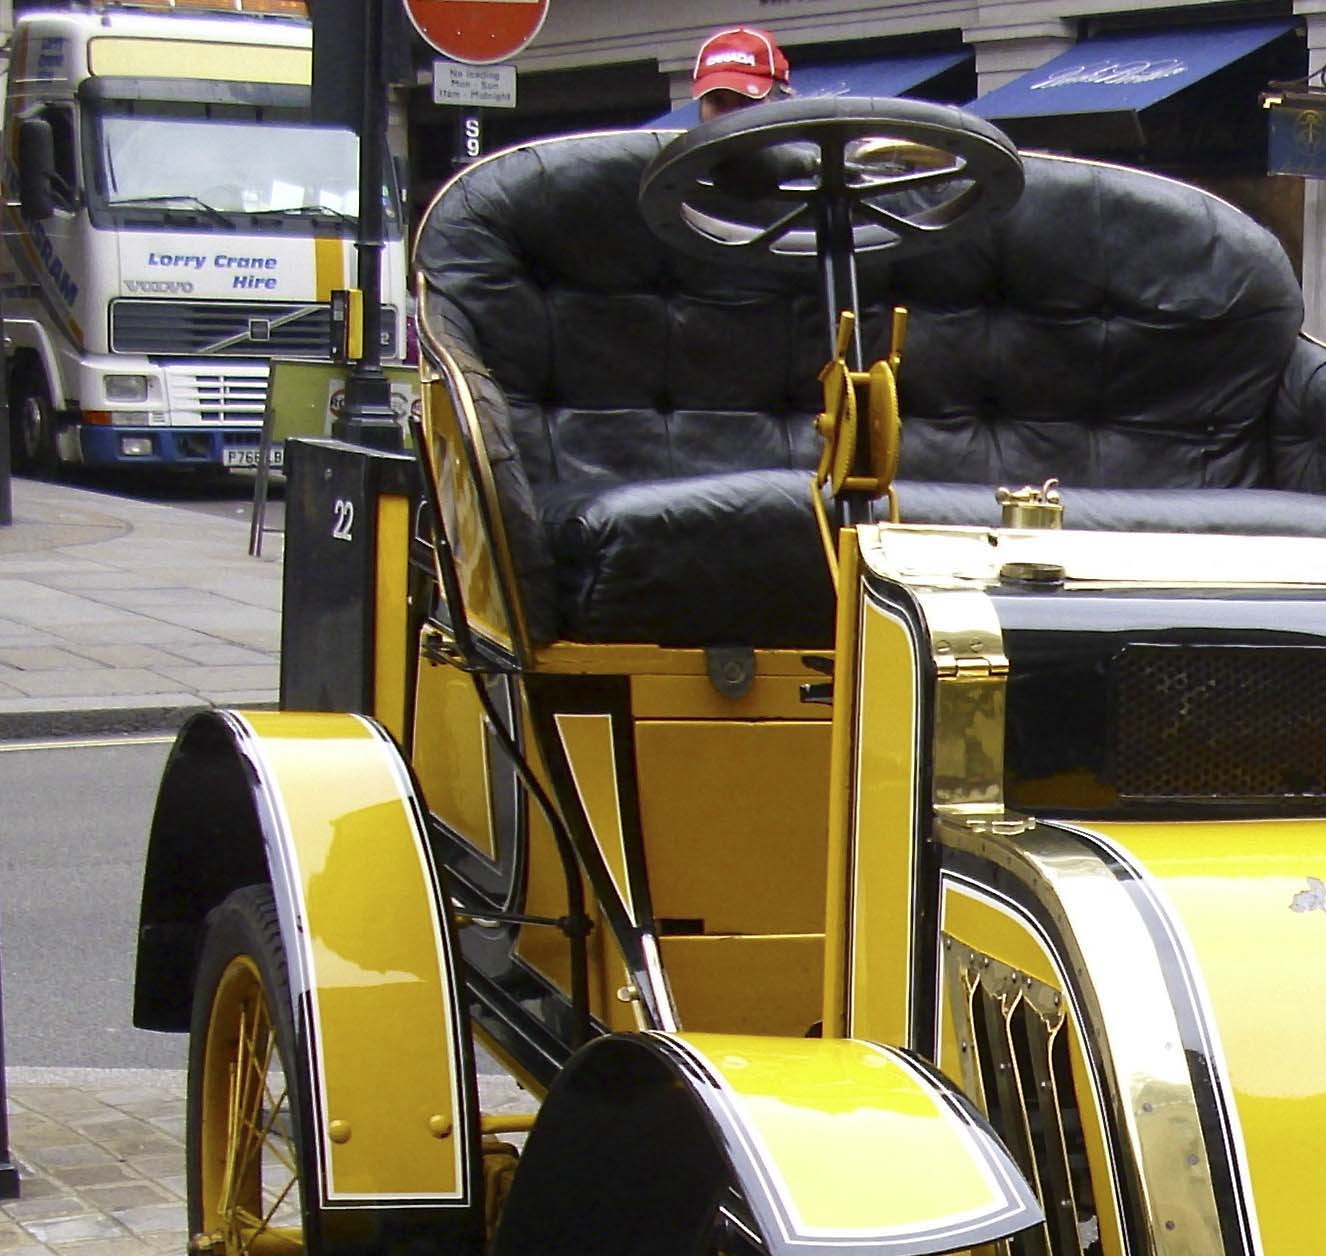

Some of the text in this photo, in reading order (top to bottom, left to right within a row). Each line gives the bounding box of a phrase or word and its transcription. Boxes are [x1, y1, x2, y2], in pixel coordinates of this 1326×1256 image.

[148, 252, 278, 270] Lorry Crane
[232, 275, 278, 289] Hire
[332, 499, 355, 542] 22
